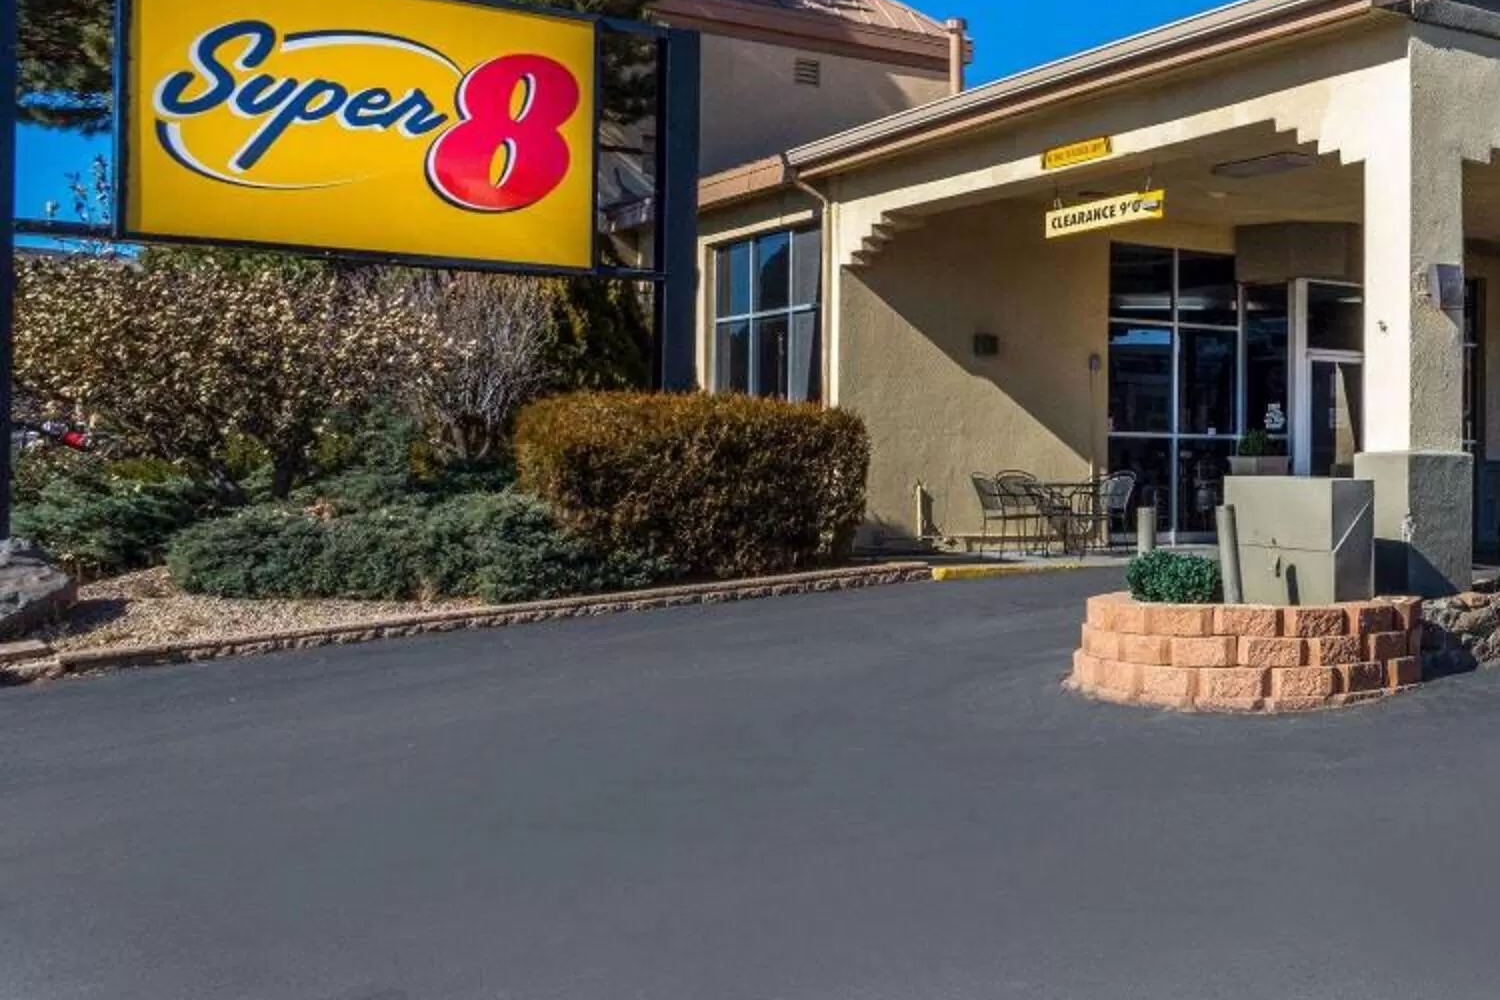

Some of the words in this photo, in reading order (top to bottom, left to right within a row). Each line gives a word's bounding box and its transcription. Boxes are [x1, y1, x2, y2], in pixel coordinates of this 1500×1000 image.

[156, 19, 449, 172] Super
[424, 53, 581, 214] 8
[1051, 204, 1116, 229] CLEARANCE
